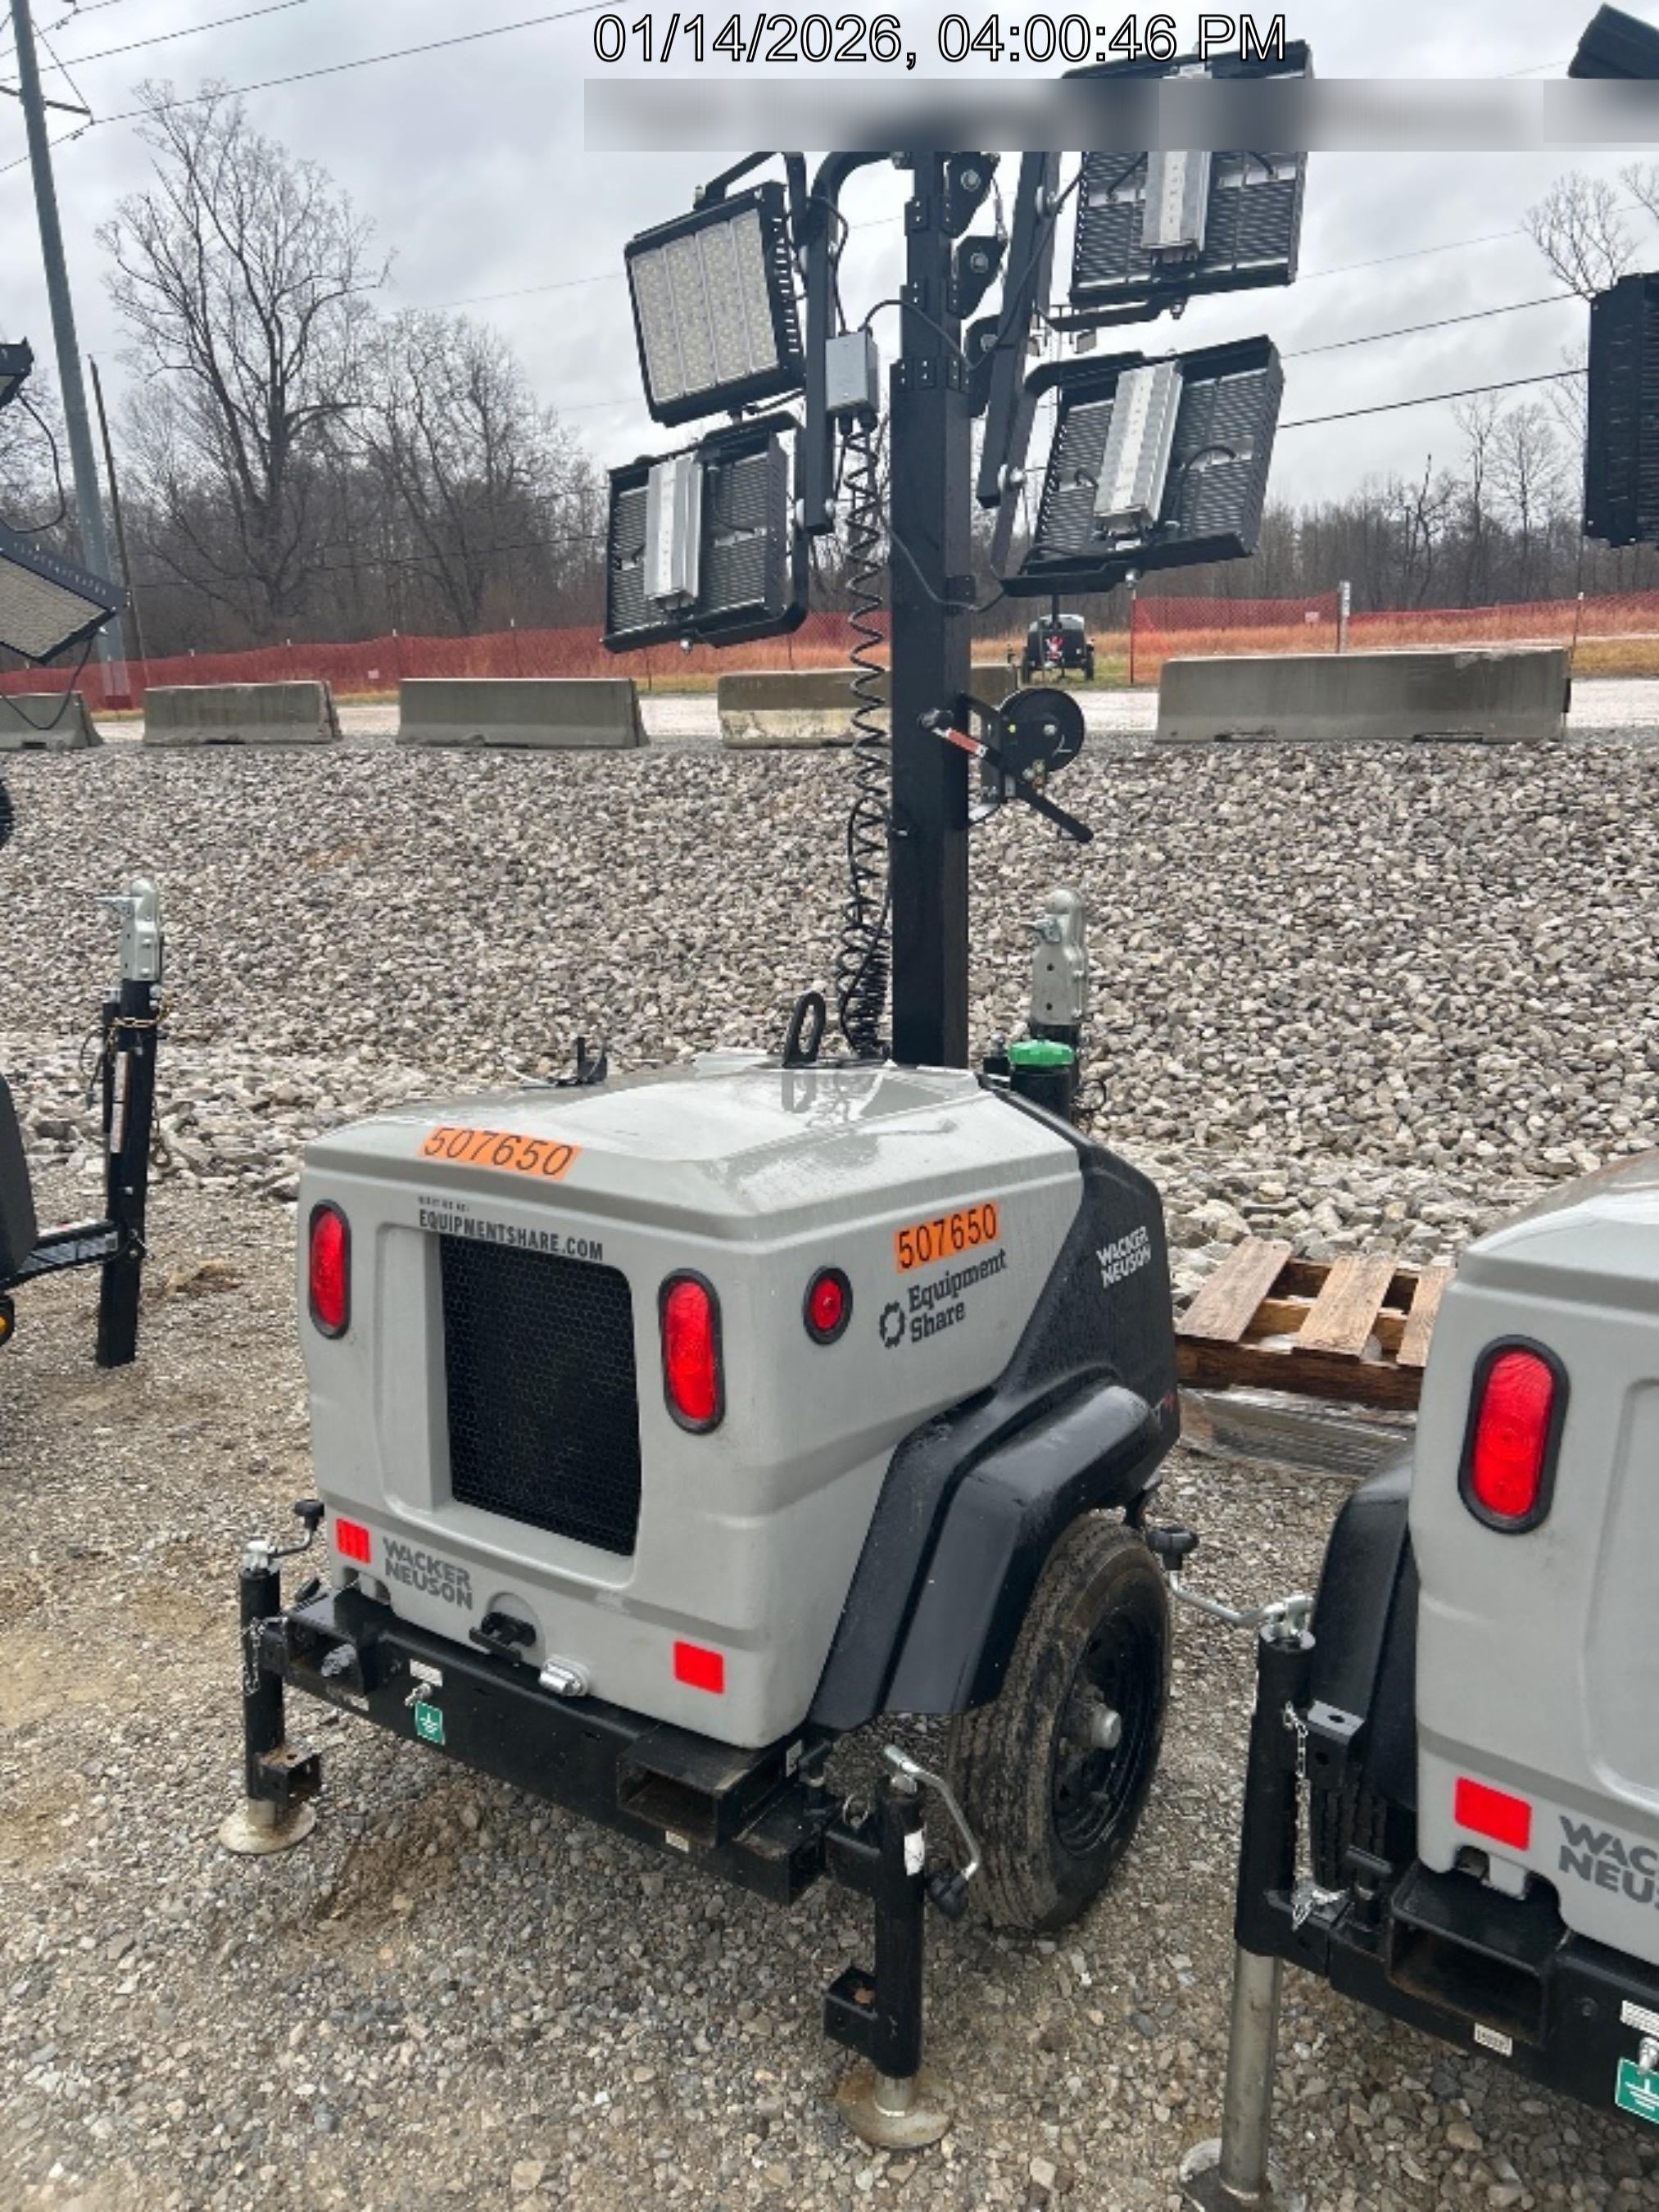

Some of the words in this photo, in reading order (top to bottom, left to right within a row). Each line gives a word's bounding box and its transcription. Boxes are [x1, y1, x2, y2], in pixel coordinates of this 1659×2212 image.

[424, 1127, 573, 1175] 507650
[419, 1209, 603, 1260] EQUIPMENTSHARE.COM
[898, 1203, 996, 1269] 507650
[1096, 1226, 1148, 1266] WACKER
[908, 1248, 1007, 1312] Equipment
[1101, 1244, 1151, 1289] NEUSON
[910, 1302, 965, 1342] Share
[383, 1536, 470, 1590] WACKER
[385, 1558, 472, 1610] NEUSON
[1559, 1844, 1659, 1911] NEU
